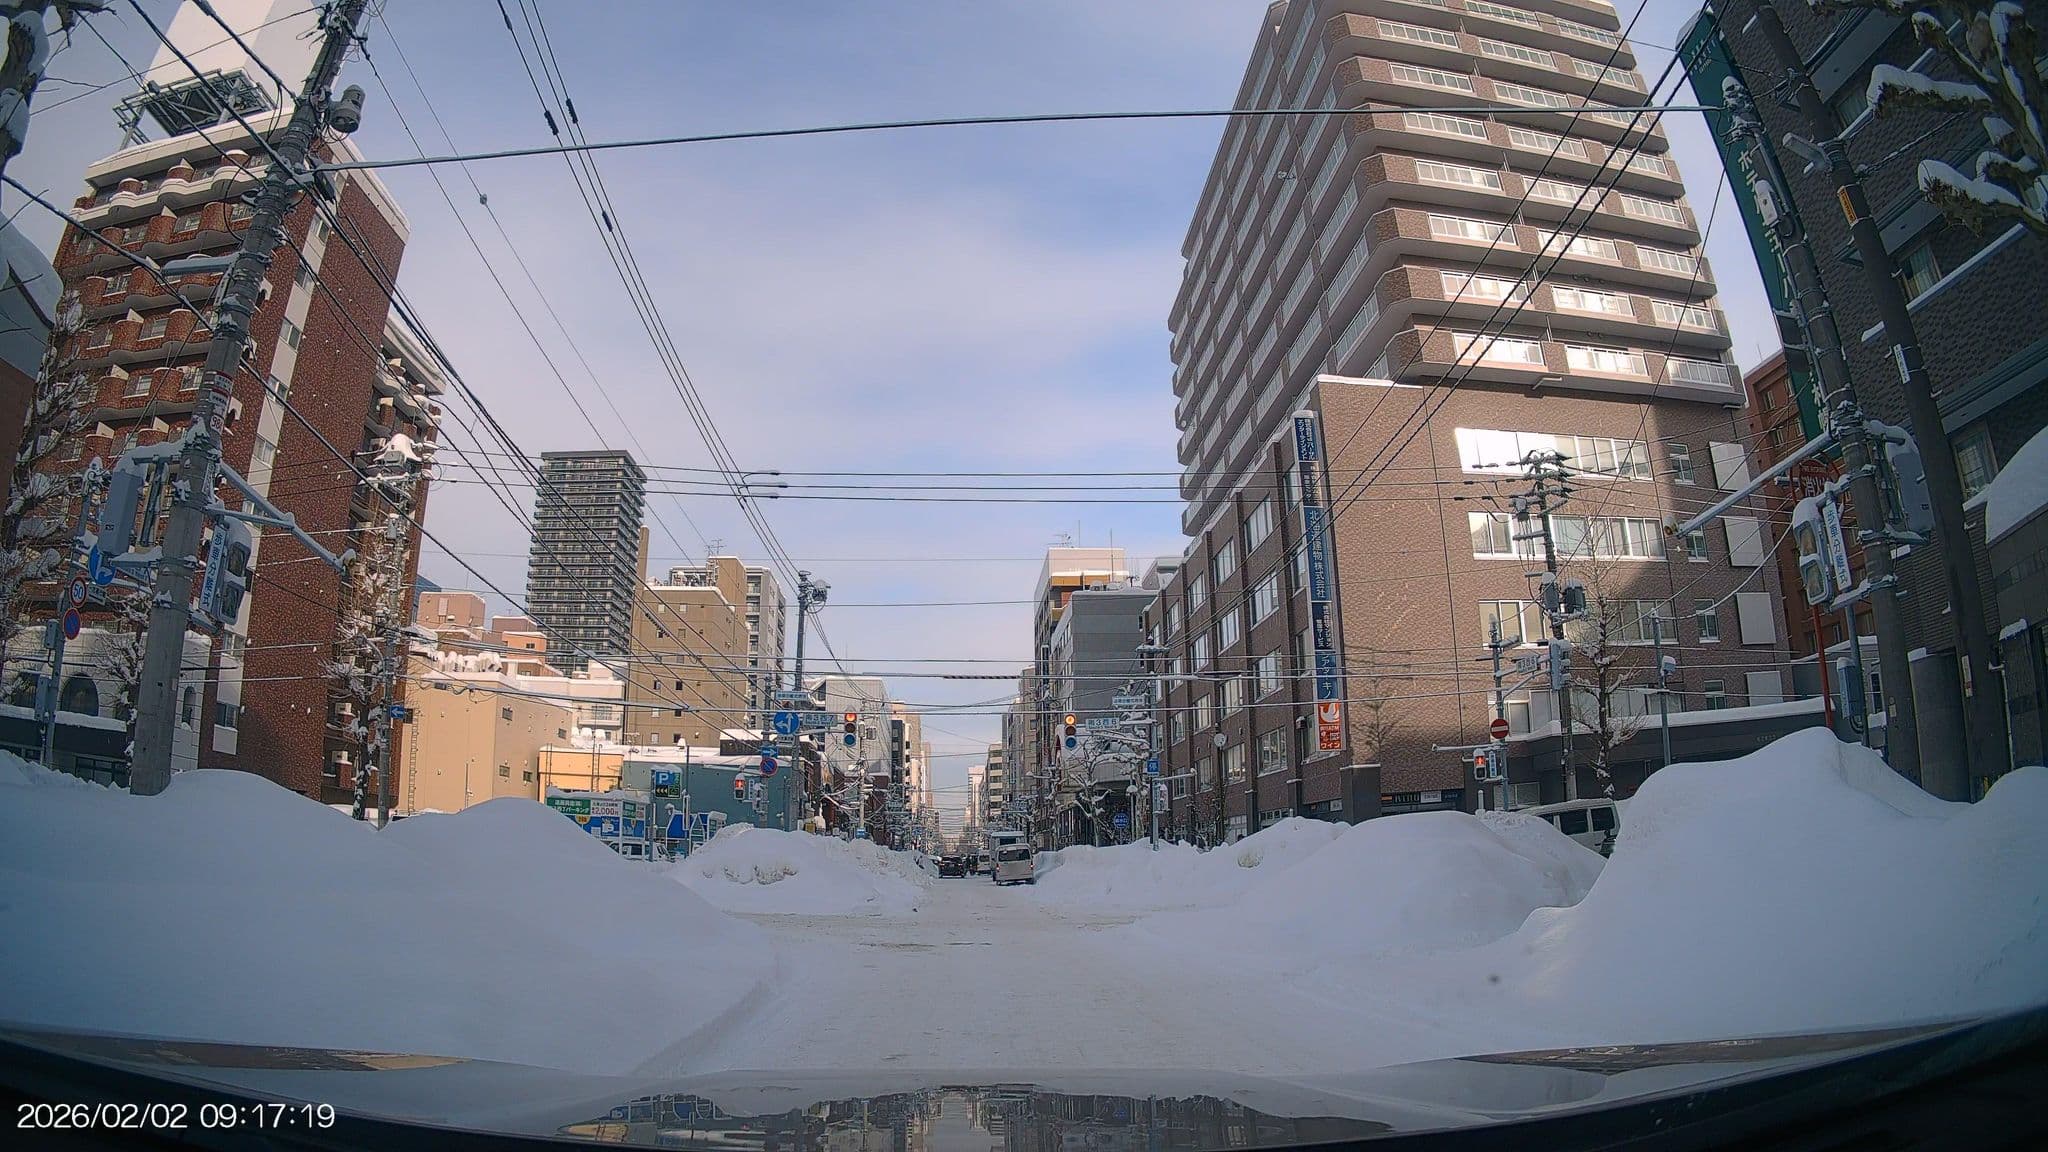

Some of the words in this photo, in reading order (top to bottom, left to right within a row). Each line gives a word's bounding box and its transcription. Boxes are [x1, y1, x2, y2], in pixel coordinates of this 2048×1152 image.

[1309, 510, 1326, 598] 北海道建物株式会社
[74, 584, 84, 599] 50
[1088, 718, 1117, 726] 南3西6
[659, 773, 669, 784] P
